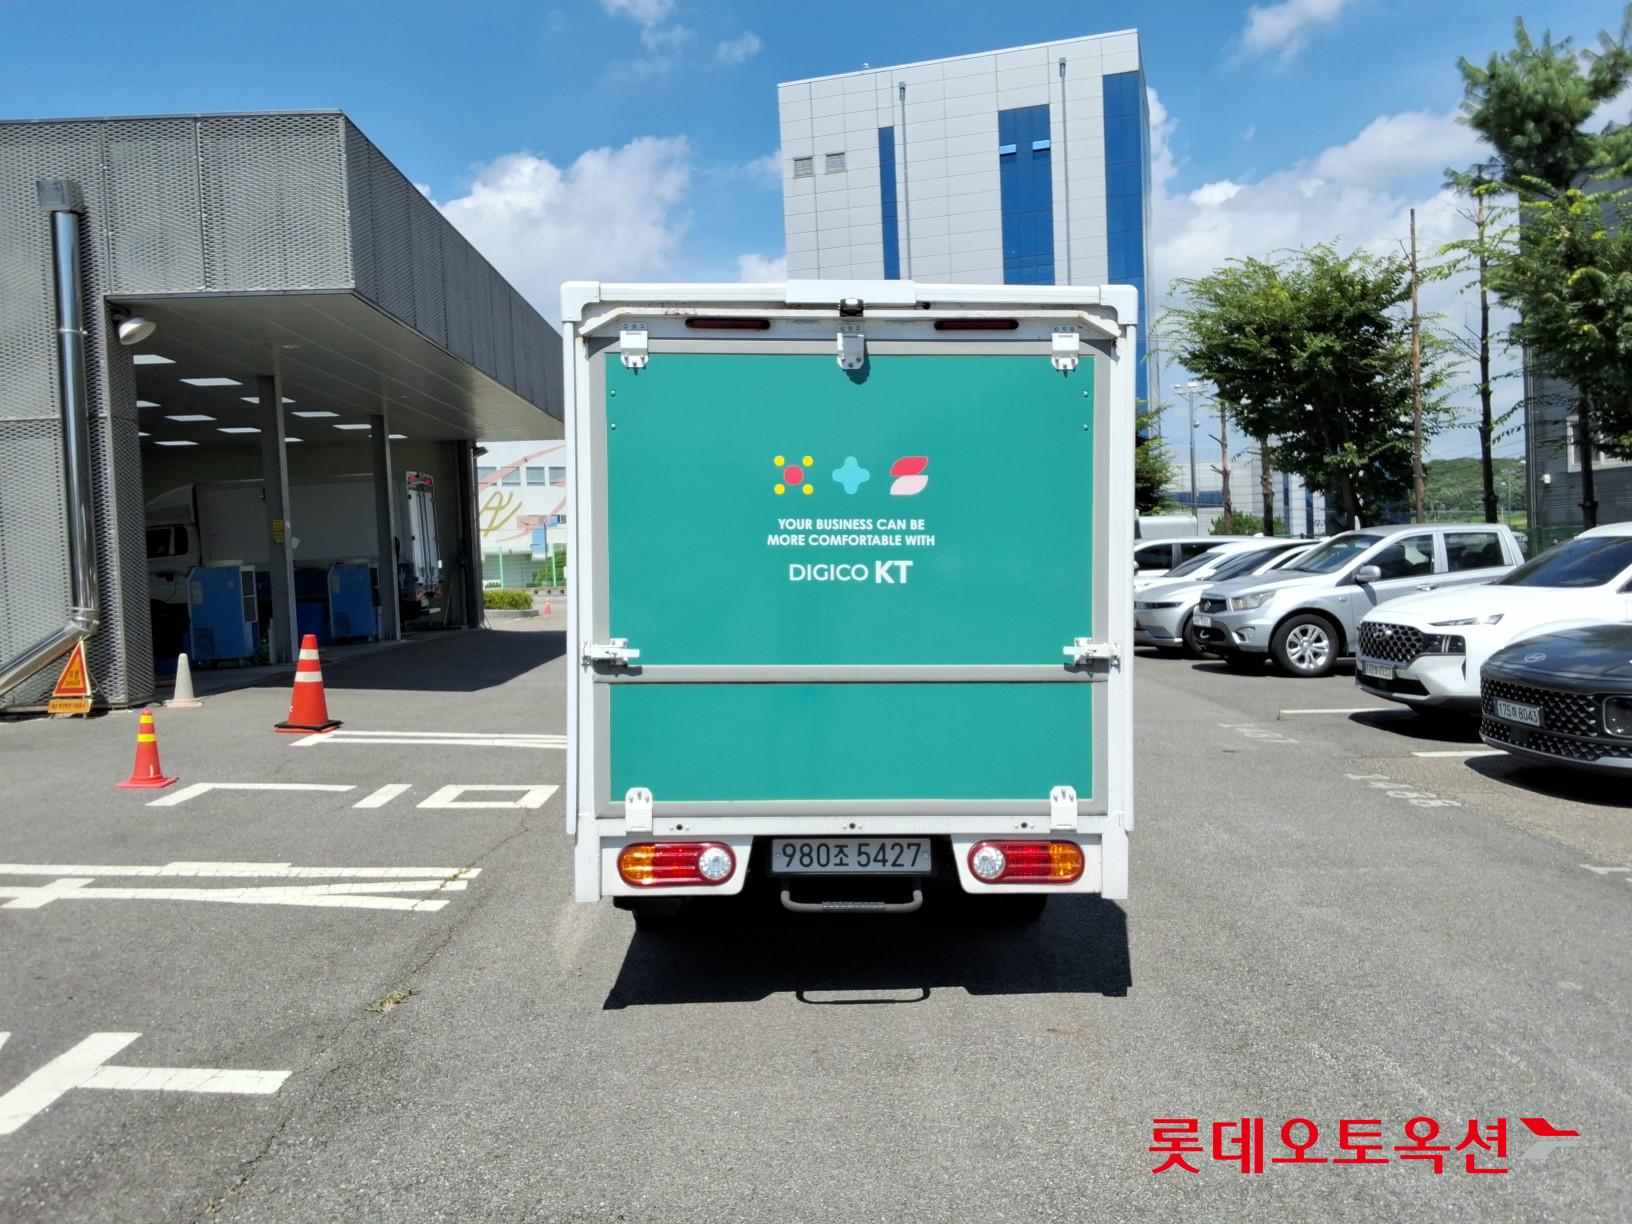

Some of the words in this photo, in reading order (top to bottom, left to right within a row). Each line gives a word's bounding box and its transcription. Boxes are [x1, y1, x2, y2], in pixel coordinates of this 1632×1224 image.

[778, 518, 813, 531] YOUR
[816, 518, 873, 531] BUSINESS
[876, 518, 906, 531] CAN
[910, 519, 925, 531] BE
[767, 534, 805, 546] MORE
[808, 534, 902, 546] COMFORTABLE
[905, 534, 935, 546] WITH
[789, 563, 869, 581] DIGICO
[875, 560, 914, 584] KT
[781, 842, 850, 868] 980조
[857, 842, 922, 868] 5427
